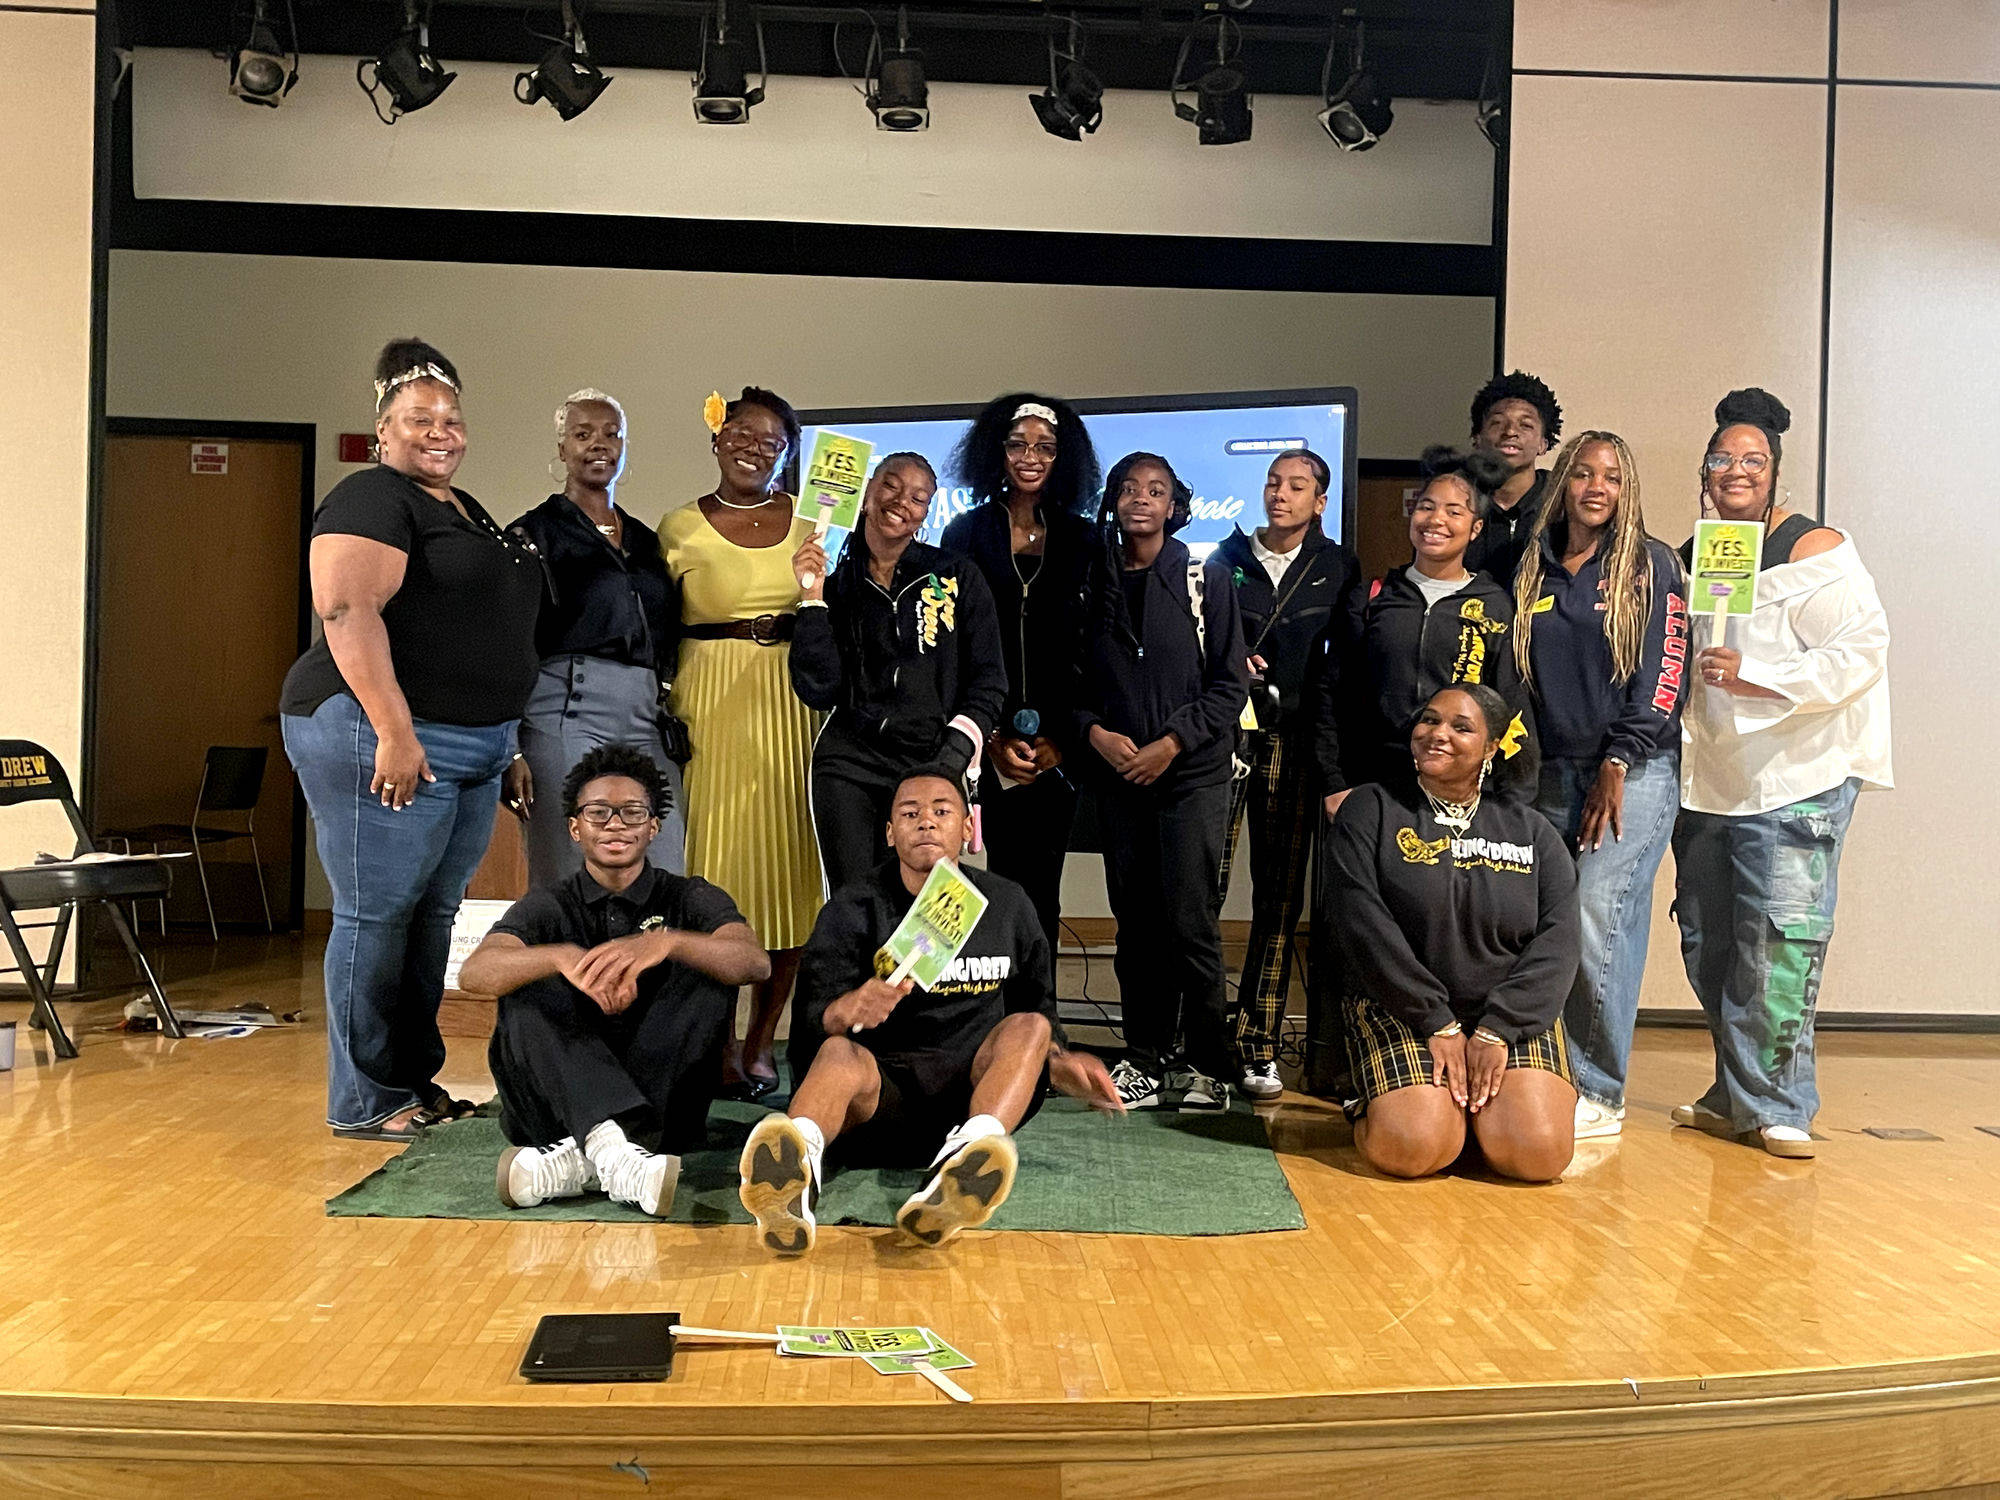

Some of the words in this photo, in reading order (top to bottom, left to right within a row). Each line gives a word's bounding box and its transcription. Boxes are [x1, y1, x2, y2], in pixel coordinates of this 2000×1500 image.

[1, 755, 47, 777] DREW
[1450, 838, 1534, 864] KING/DREW
[940, 956, 1011, 982] NG/DREW
